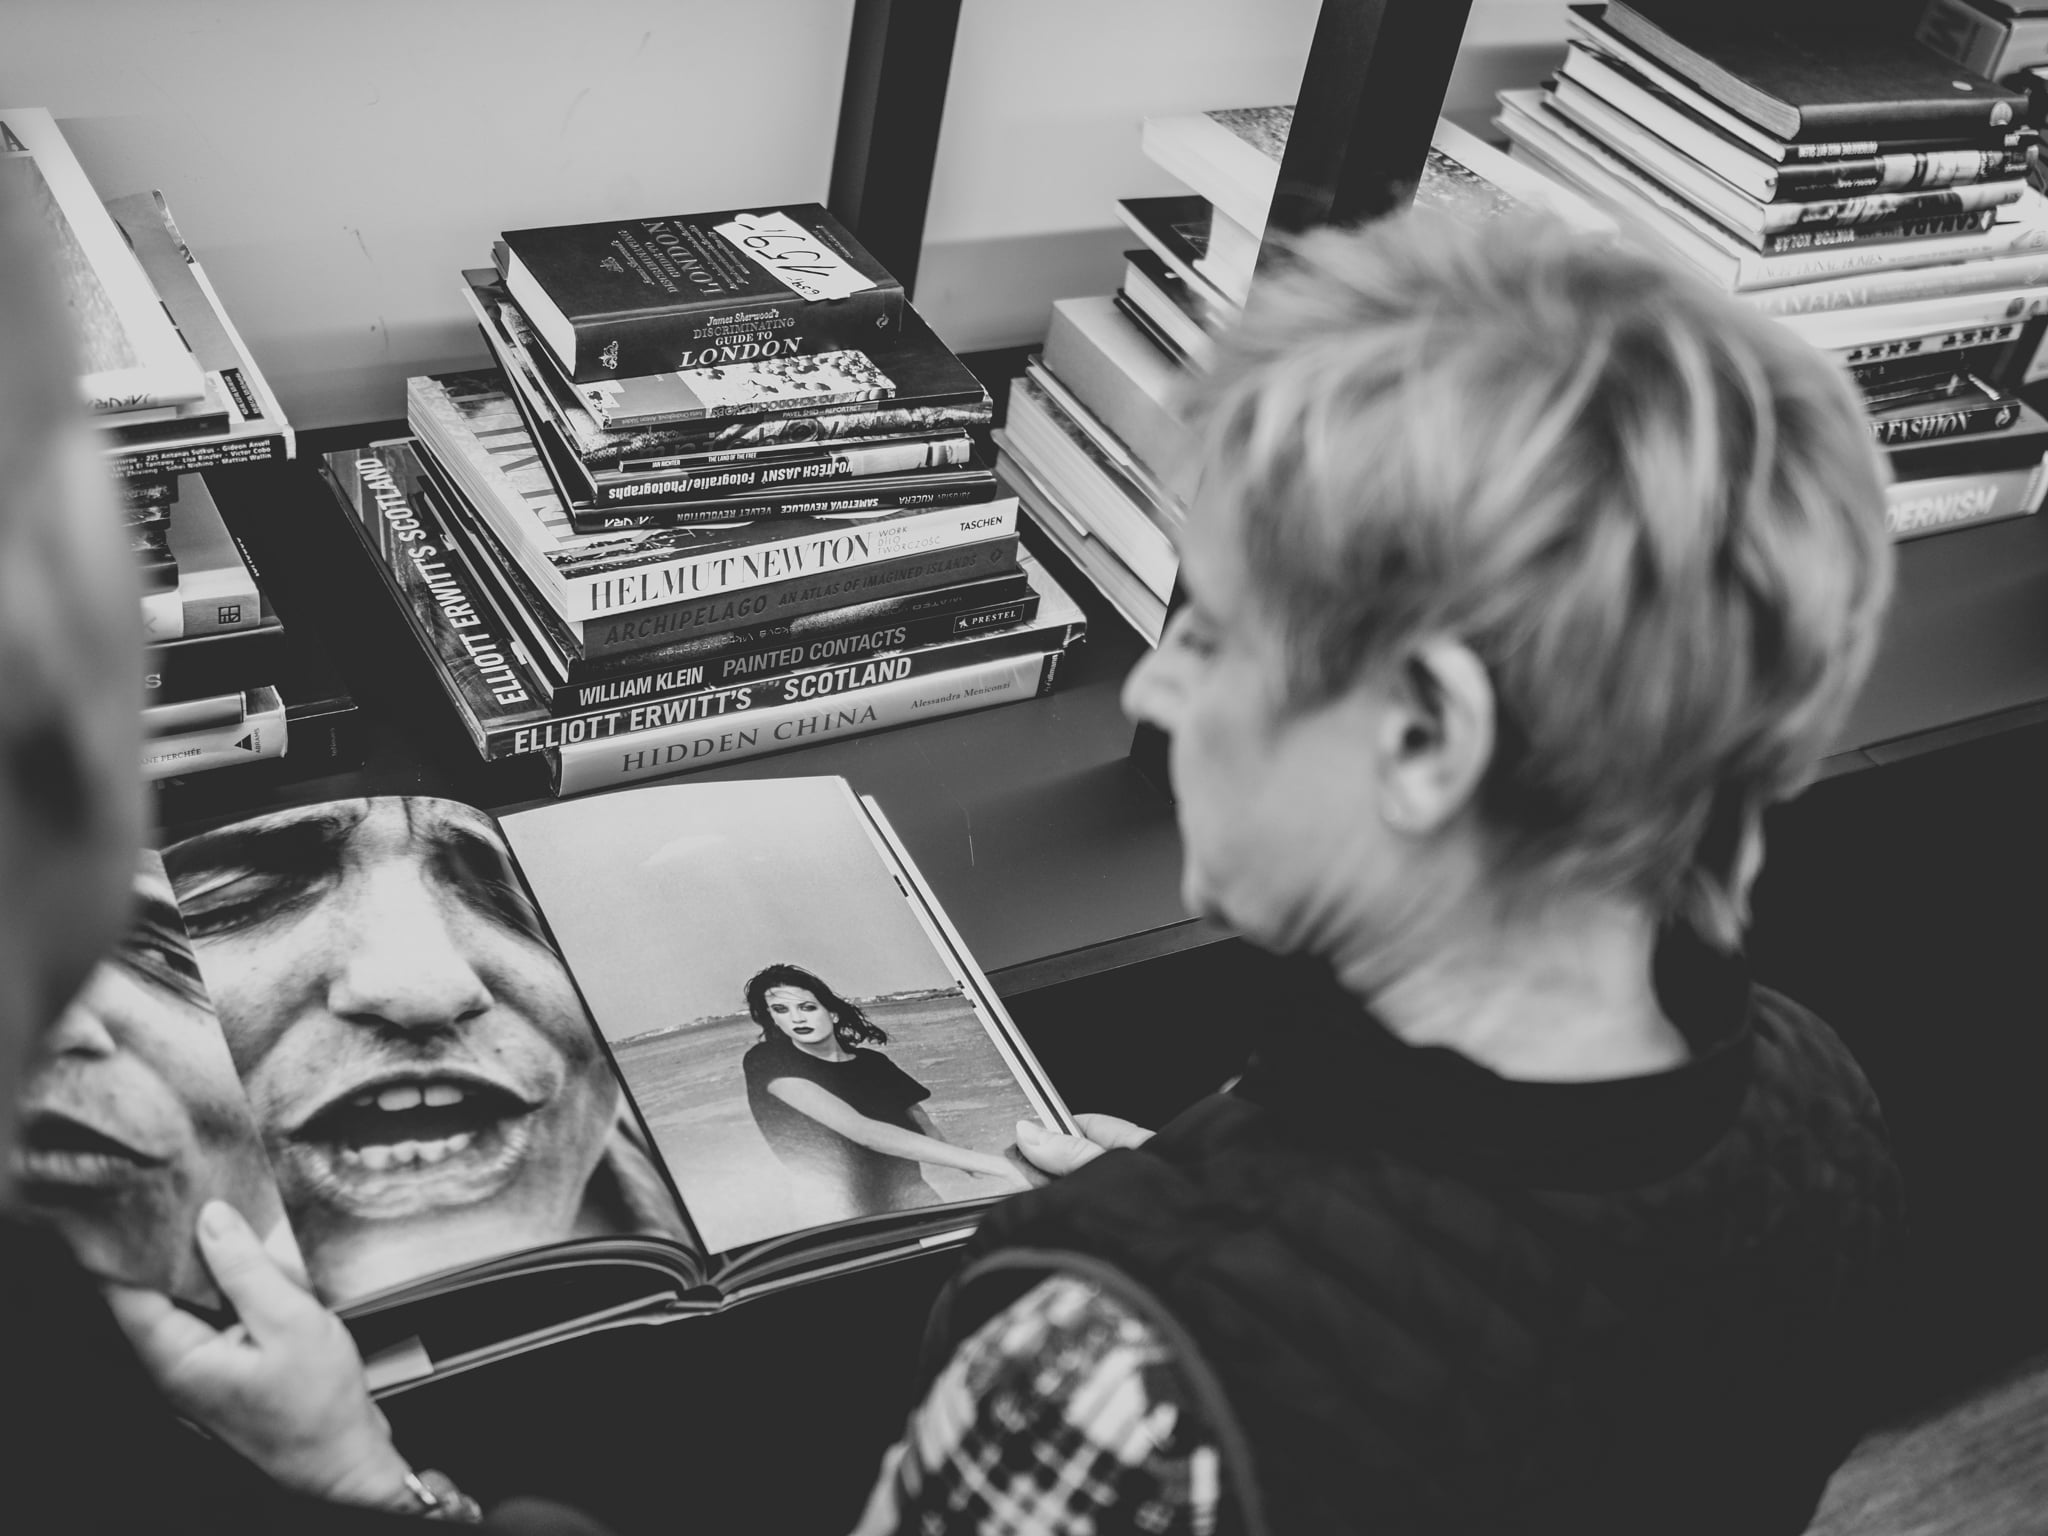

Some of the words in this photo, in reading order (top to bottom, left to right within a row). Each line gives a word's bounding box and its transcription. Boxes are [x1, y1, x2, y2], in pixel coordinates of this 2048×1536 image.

[1902, 212, 1979, 238] CANADA
[641, 221, 727, 296] LONDON
[644, 241, 660, 256] TO
[618, 230, 680, 293] DISCRIMINATING
[655, 253, 681, 278] GUIDE
[692, 317, 796, 340] DISCRIMINATING
[706, 315, 733, 327] James
[734, 307, 780, 323] Sherwood's
[715, 333, 754, 347] GUIDE
[757, 330, 773, 341] TO
[678, 336, 803, 368] LONDON
[782, 411, 802, 419] PAVEL
[145, 459, 175, 469] Tantawy
[182, 455, 196, 464] Lisa
[230, 448, 251, 458] Victor
[253, 446, 271, 455] Cobo
[161, 450, 190, 460] Antanas
[222, 443, 247, 452] Gideon
[222, 456, 248, 465] Mattias
[249, 453, 272, 463] Wallin
[708, 455, 717, 463] THE
[716, 454, 729, 463] LAND
[736, 453, 745, 461] THE
[608, 472, 756, 500] Fotografie/Photographs
[761, 464, 802, 486] JASNÝ
[354, 457, 428, 543] SCOTLAND
[780, 501, 828, 515] REVOLUCE
[830, 496, 879, 512] SAMETOVÁ
[1884, 484, 1999, 533] DERNISM
[676, 508, 737, 522] REVOLUTION
[739, 506, 772, 518] VELVET
[960, 515, 1004, 532] TASCHEN
[878, 525, 909, 538] WORK
[589, 557, 736, 612] HELMUT
[741, 531, 873, 584] NEWTON
[407, 544, 482, 630] ERWITT'S
[603, 594, 768, 646] ARCHIPELAGO
[778, 591, 798, 606] AN
[800, 583, 841, 602] ATLAS
[843, 580, 860, 594] OF
[862, 565, 924, 589] IMAGINED
[926, 554, 978, 574] ISLANDS
[971, 609, 1017, 626] PRESTEL
[458, 632, 530, 707] ELLIOTT
[579, 675, 653, 707] WILLIAM
[655, 666, 705, 693] KLEIN
[722, 645, 804, 678] PAINTED
[808, 625, 907, 662] CONTACTS
[514, 711, 625, 754] ELLIOTT
[629, 687, 752, 733] ERWITT'S
[783, 656, 913, 702] SCOTLAND
[910, 691, 963, 710] Alessandra
[964, 681, 1013, 700] Meniconzi
[254, 727, 262, 754] ABRAMS
[621, 727, 761, 773] HIDDEN
[773, 704, 878, 741] CHINA
[160, 747, 202, 763] PERCHÉE
